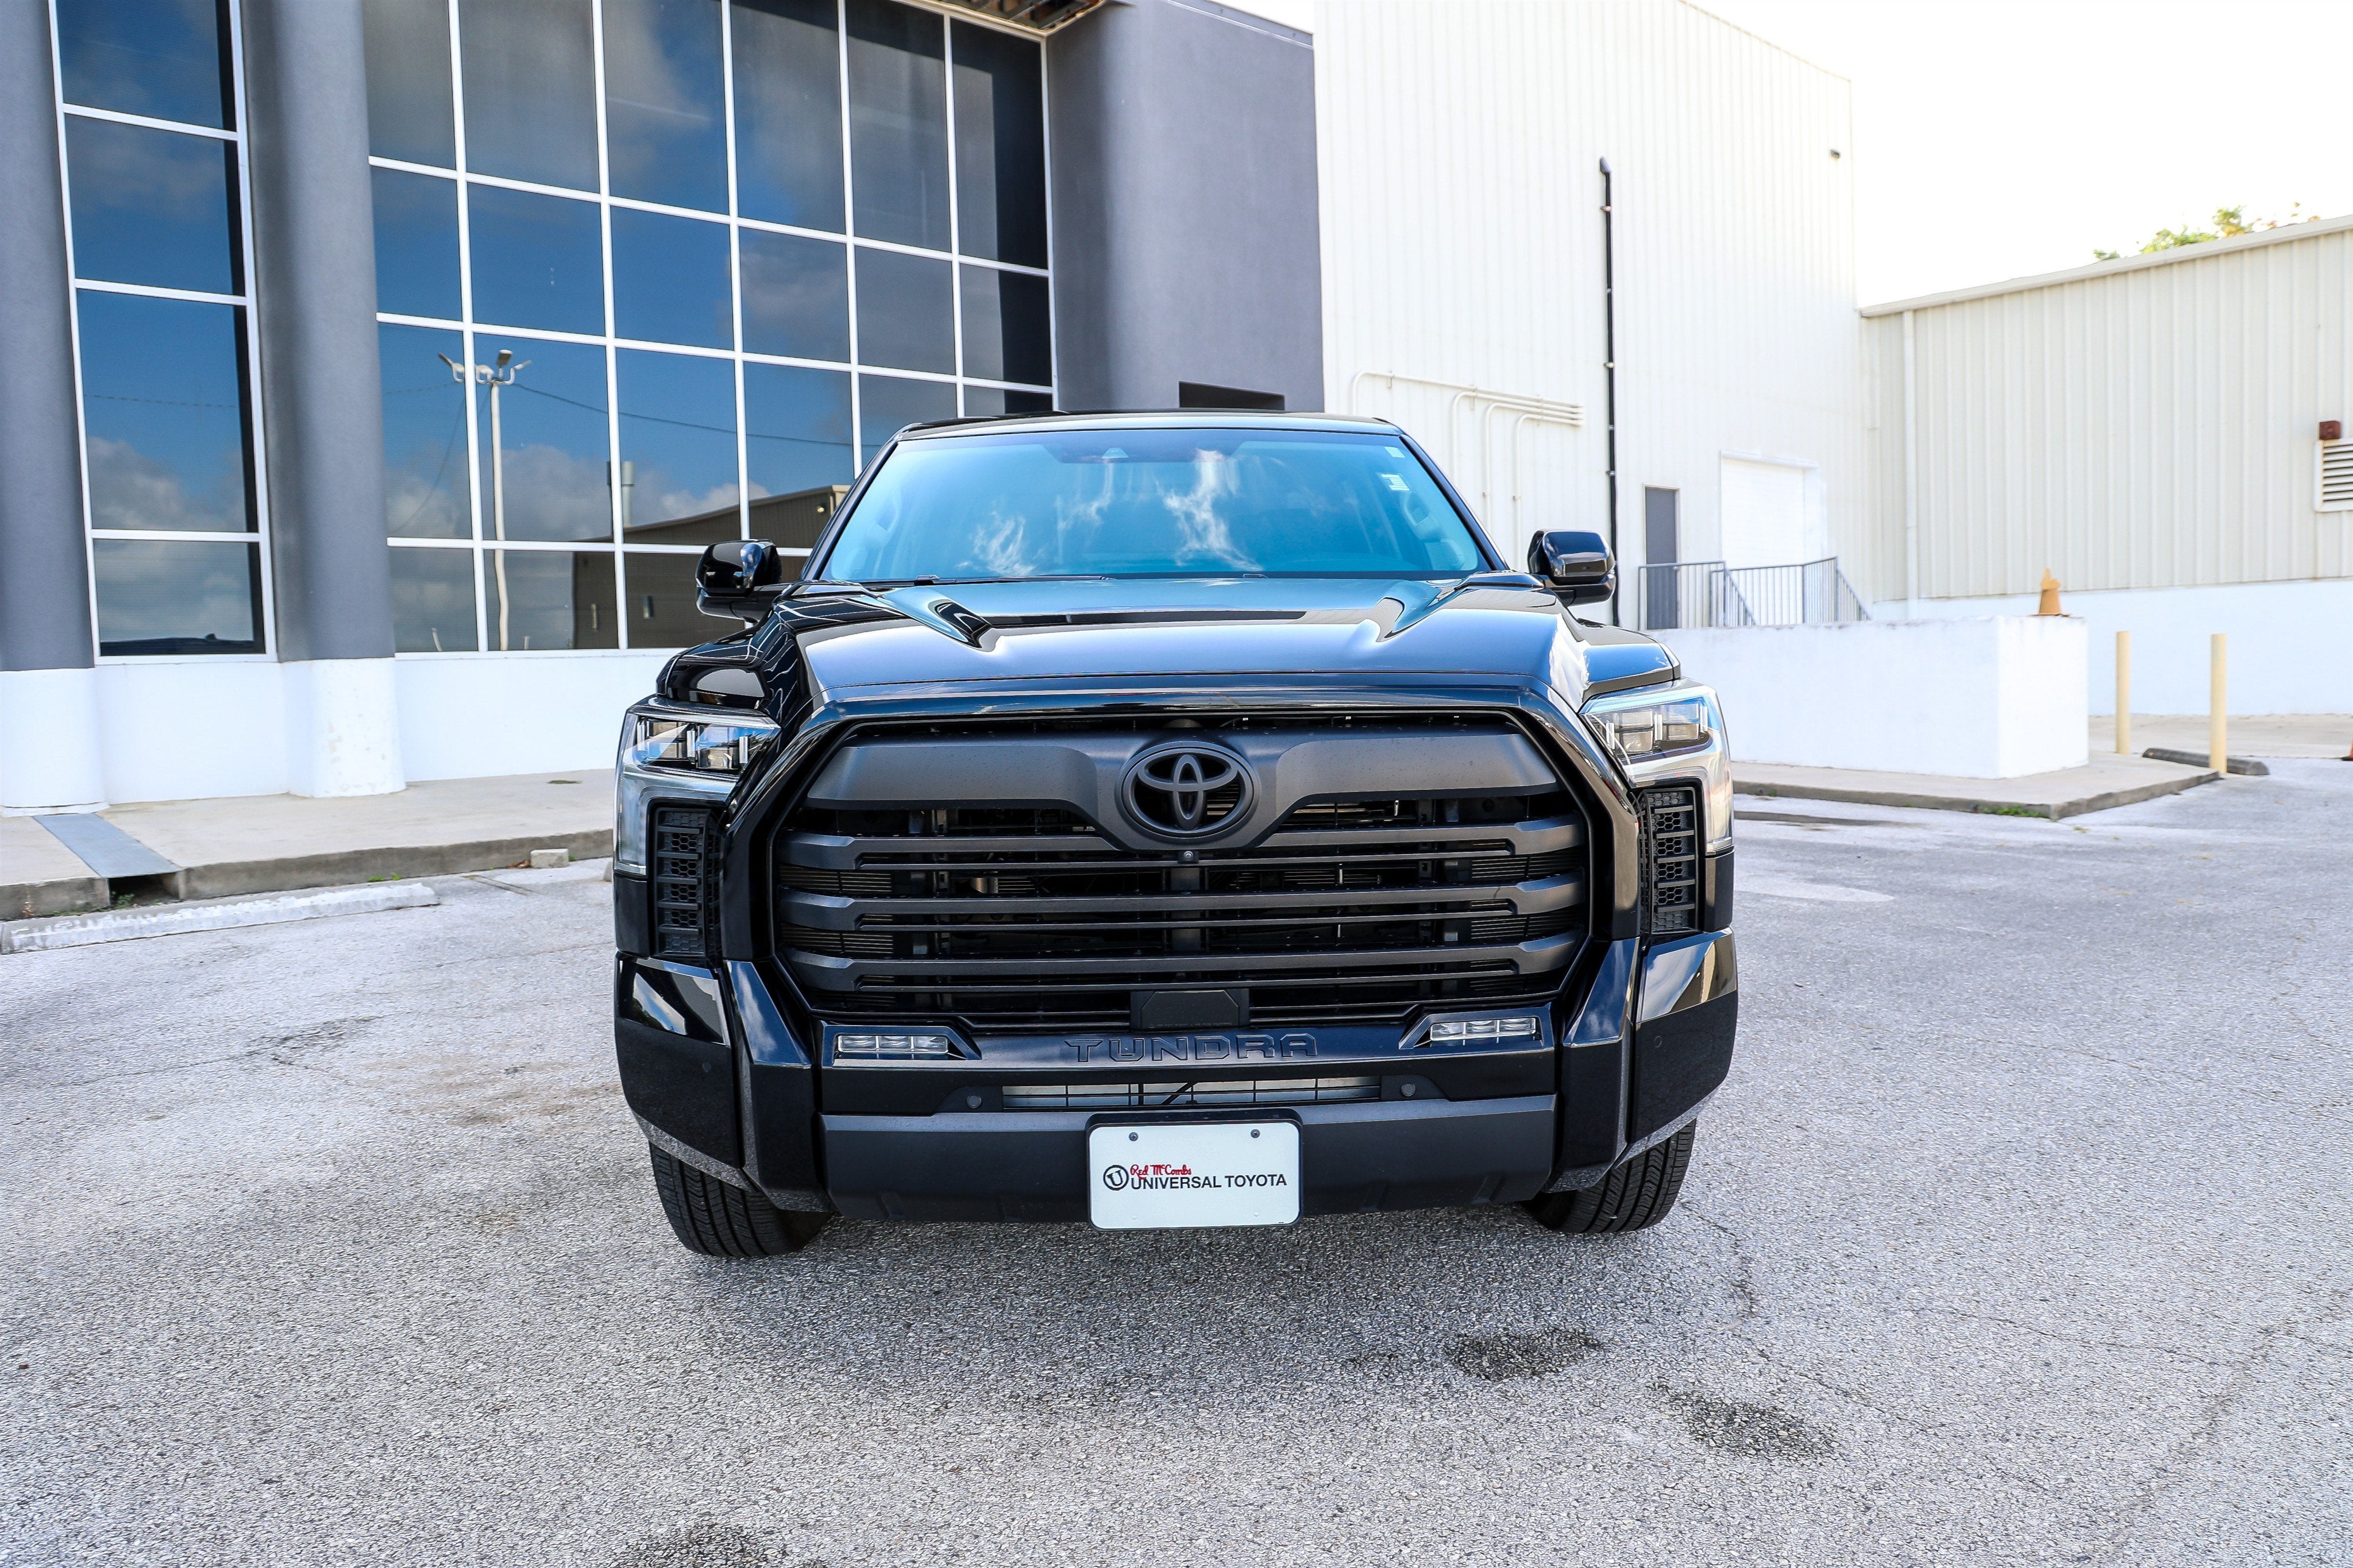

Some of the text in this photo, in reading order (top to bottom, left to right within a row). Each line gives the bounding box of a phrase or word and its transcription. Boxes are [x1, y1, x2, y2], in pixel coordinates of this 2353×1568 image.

[1064, 1033, 1318, 1063] TUNDRA
[1130, 1164, 1149, 1180] Red
[1131, 1173, 1287, 1189] UNIVERSAL TOYOTA
